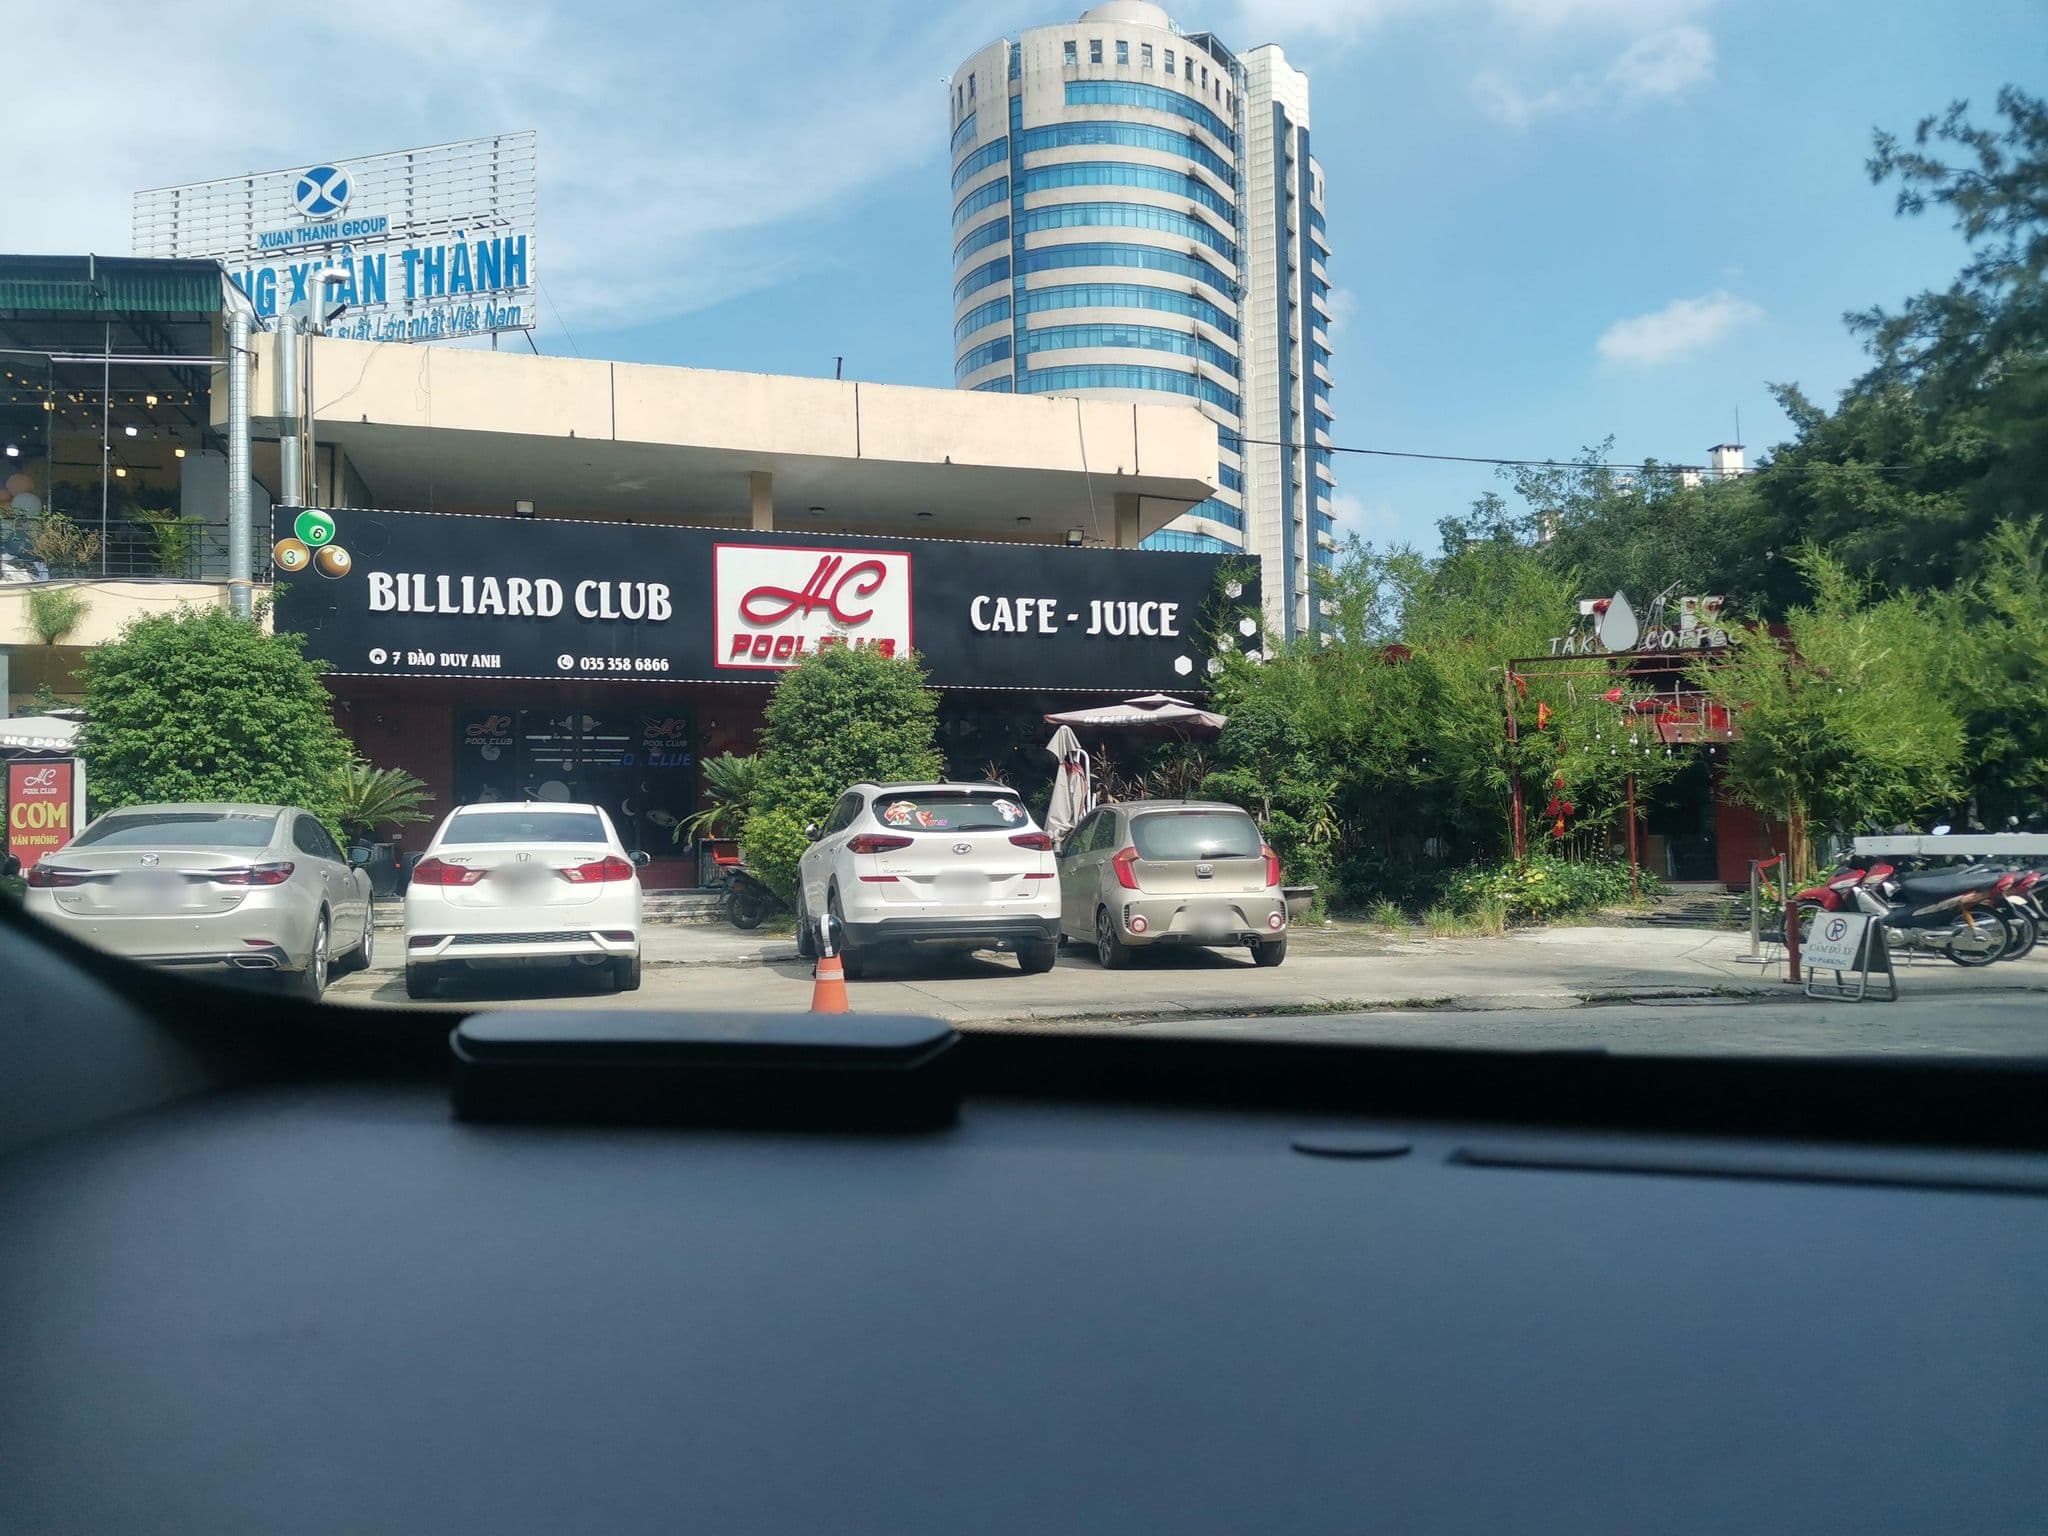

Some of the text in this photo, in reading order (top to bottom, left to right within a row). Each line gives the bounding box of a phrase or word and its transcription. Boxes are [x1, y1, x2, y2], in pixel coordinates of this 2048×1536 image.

[260, 217, 387, 249] XUAN THANH GROUP
[401, 229, 527, 299] THÀNH
[410, 304, 446, 338] nhất
[450, 303, 480, 332] Việt
[485, 302, 521, 327] Nam
[313, 527, 324, 539] 6
[286, 550, 296, 564] 3
[367, 571, 673, 622] BILLIARD CLUB
[740, 555, 887, 625] HC
[970, 595, 1058, 633] CAFE
[1086, 600, 1180, 637] JUICE
[391, 648, 501, 669] 7 ĐÀO DUY ANH
[731, 633, 810, 659] POOL
[580, 656, 669, 672] 035 358 6866
[4, 736, 28, 746] HC
[11, 801, 68, 829] CƠM
[30, 833, 59, 846] PHÒNG
